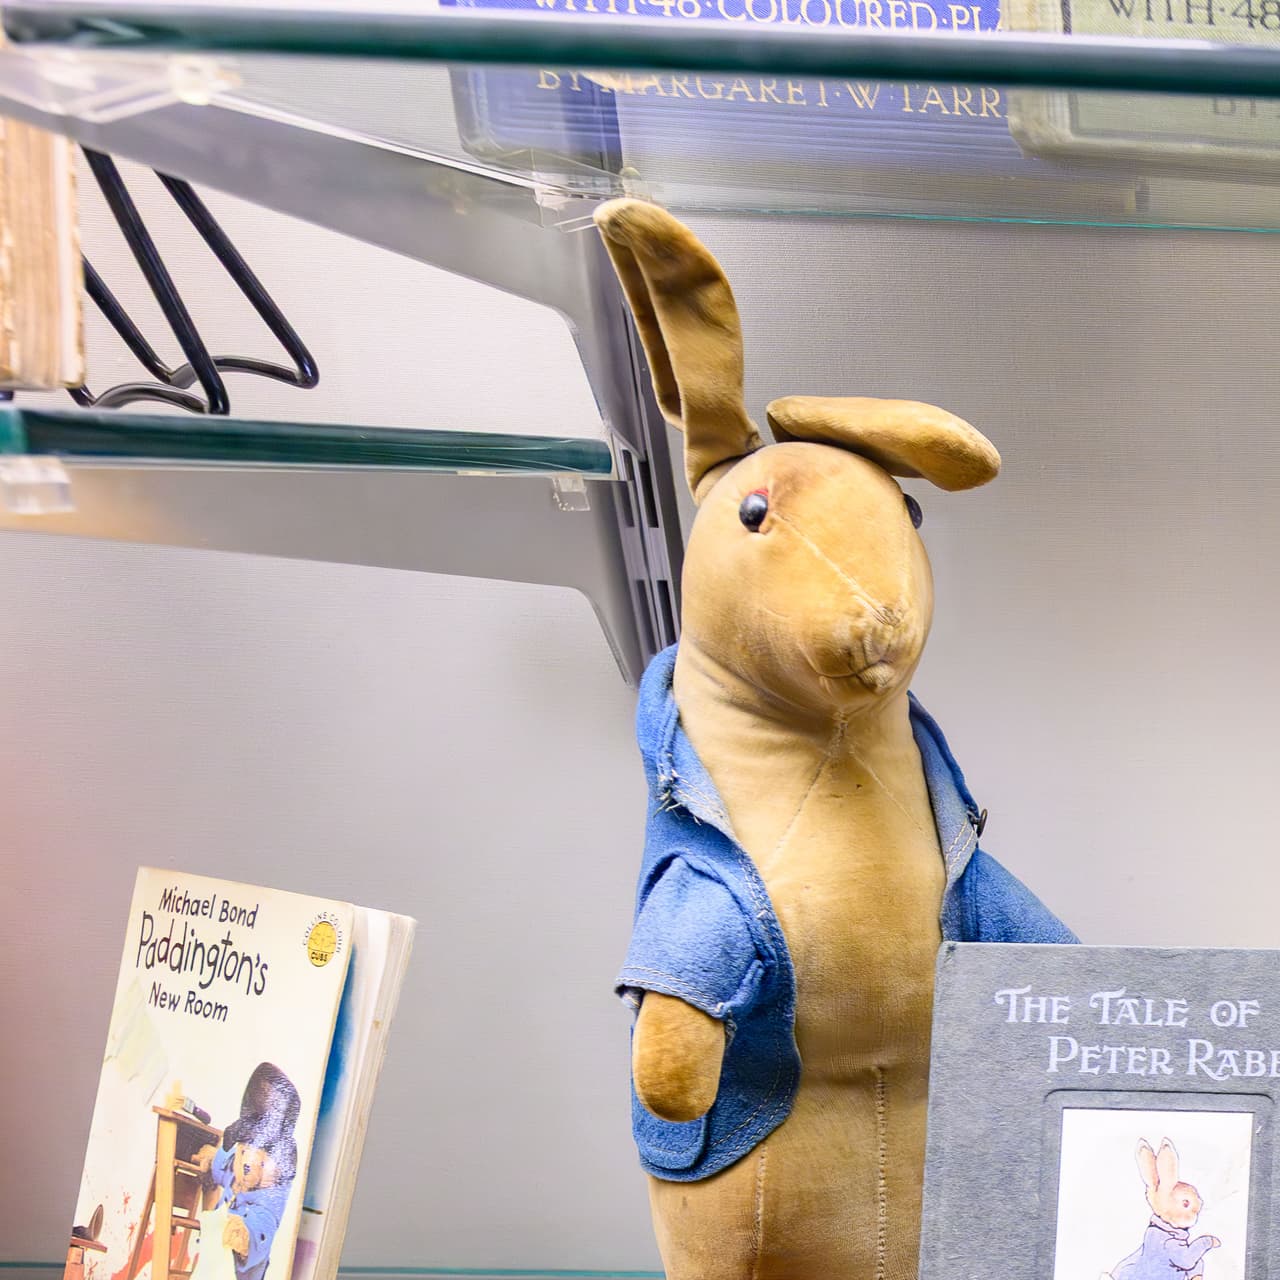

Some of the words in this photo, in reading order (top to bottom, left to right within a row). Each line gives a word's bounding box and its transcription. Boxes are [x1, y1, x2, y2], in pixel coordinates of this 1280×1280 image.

[159, 886, 216, 919] Michael
[219, 900, 258, 928] Bond
[136, 911, 268, 996] Paddington's
[149, 981, 181, 1012] New
[185, 991, 228, 1022] Room
[994, 985, 1071, 1024] THE
[1089, 986, 1189, 1027] TALE
[1210, 999, 1260, 1027] OF
[1046, 1036, 1173, 1075] PETER
